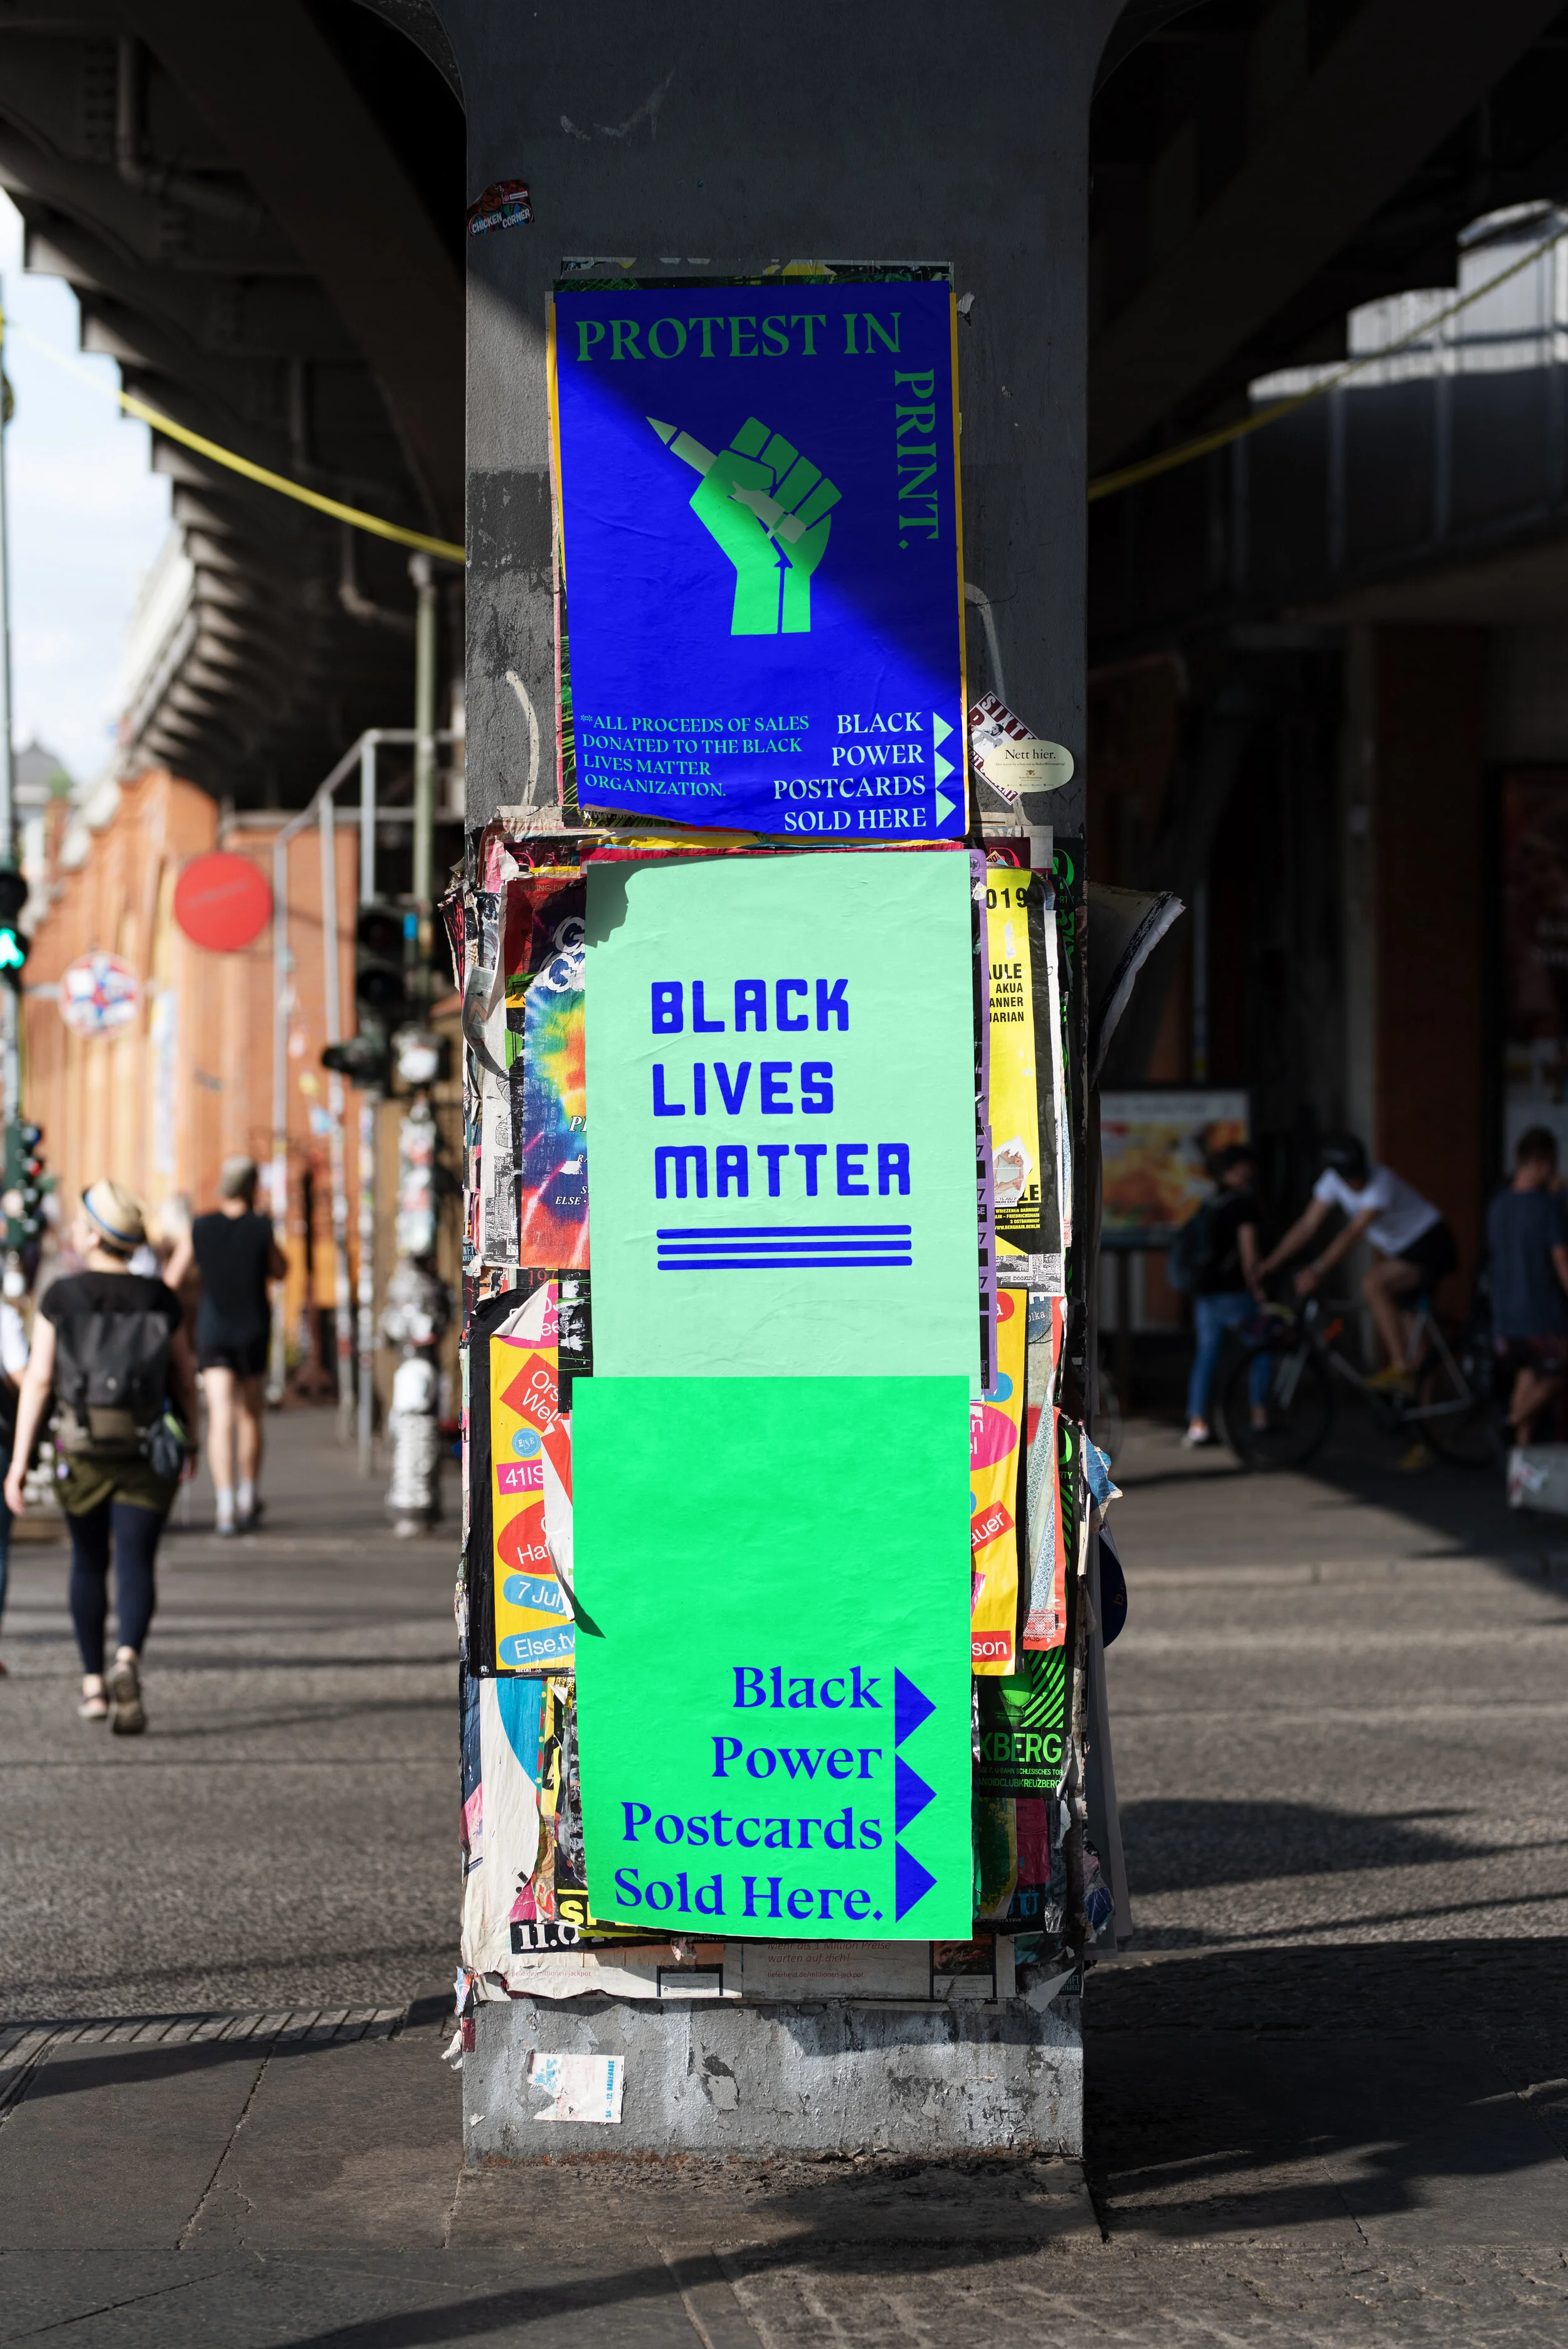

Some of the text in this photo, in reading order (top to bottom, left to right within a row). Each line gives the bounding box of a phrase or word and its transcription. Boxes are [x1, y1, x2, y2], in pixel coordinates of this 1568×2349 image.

[472, 208, 531, 233] CHICKEN CORNER
[575, 312, 902, 361] PROTEST IN
[894, 368, 939, 549] PRINT.
[632, 718, 723, 733] PROCEEDS
[728, 718, 751, 732] OF
[755, 716, 809, 731] SALES
[837, 712, 924, 734] BLACK
[582, 734, 803, 753] DONATED TO THE BLACK
[832, 744, 925, 766] POWER
[1005, 749, 1056, 759] Nett hier.
[583, 755, 711, 775] LIVES MATTER
[585, 774, 726, 797] ORGANIZATION.
[773, 775, 926, 799] POSTCARDS
[785, 807, 926, 831] SOLD HERE
[987, 888, 1028, 909] 019
[995, 982, 1024, 994] AKUA
[651, 978, 849, 1034] BLACK
[652, 1061, 834, 1116] LIVES
[654, 1143, 911, 1199] MATTER
[555, 1196, 581, 1206] ELSE
[519, 1581, 565, 1614] 7 Jul
[972, 1640, 1007, 1657] son
[732, 1665, 884, 1709] Black
[711, 1736, 883, 1779] Power
[620, 1801, 883, 1850] Postcards
[615, 1867, 726, 1916] Sold
[741, 1875, 884, 1921] Here.
[824, 1941, 858, 1950] Million
[862, 1941, 891, 1950] Preise
[768, 1953, 850, 1963] warten auf dich!
[767, 1970, 864, 1979] lieferheld.de/millionen-jackpot
